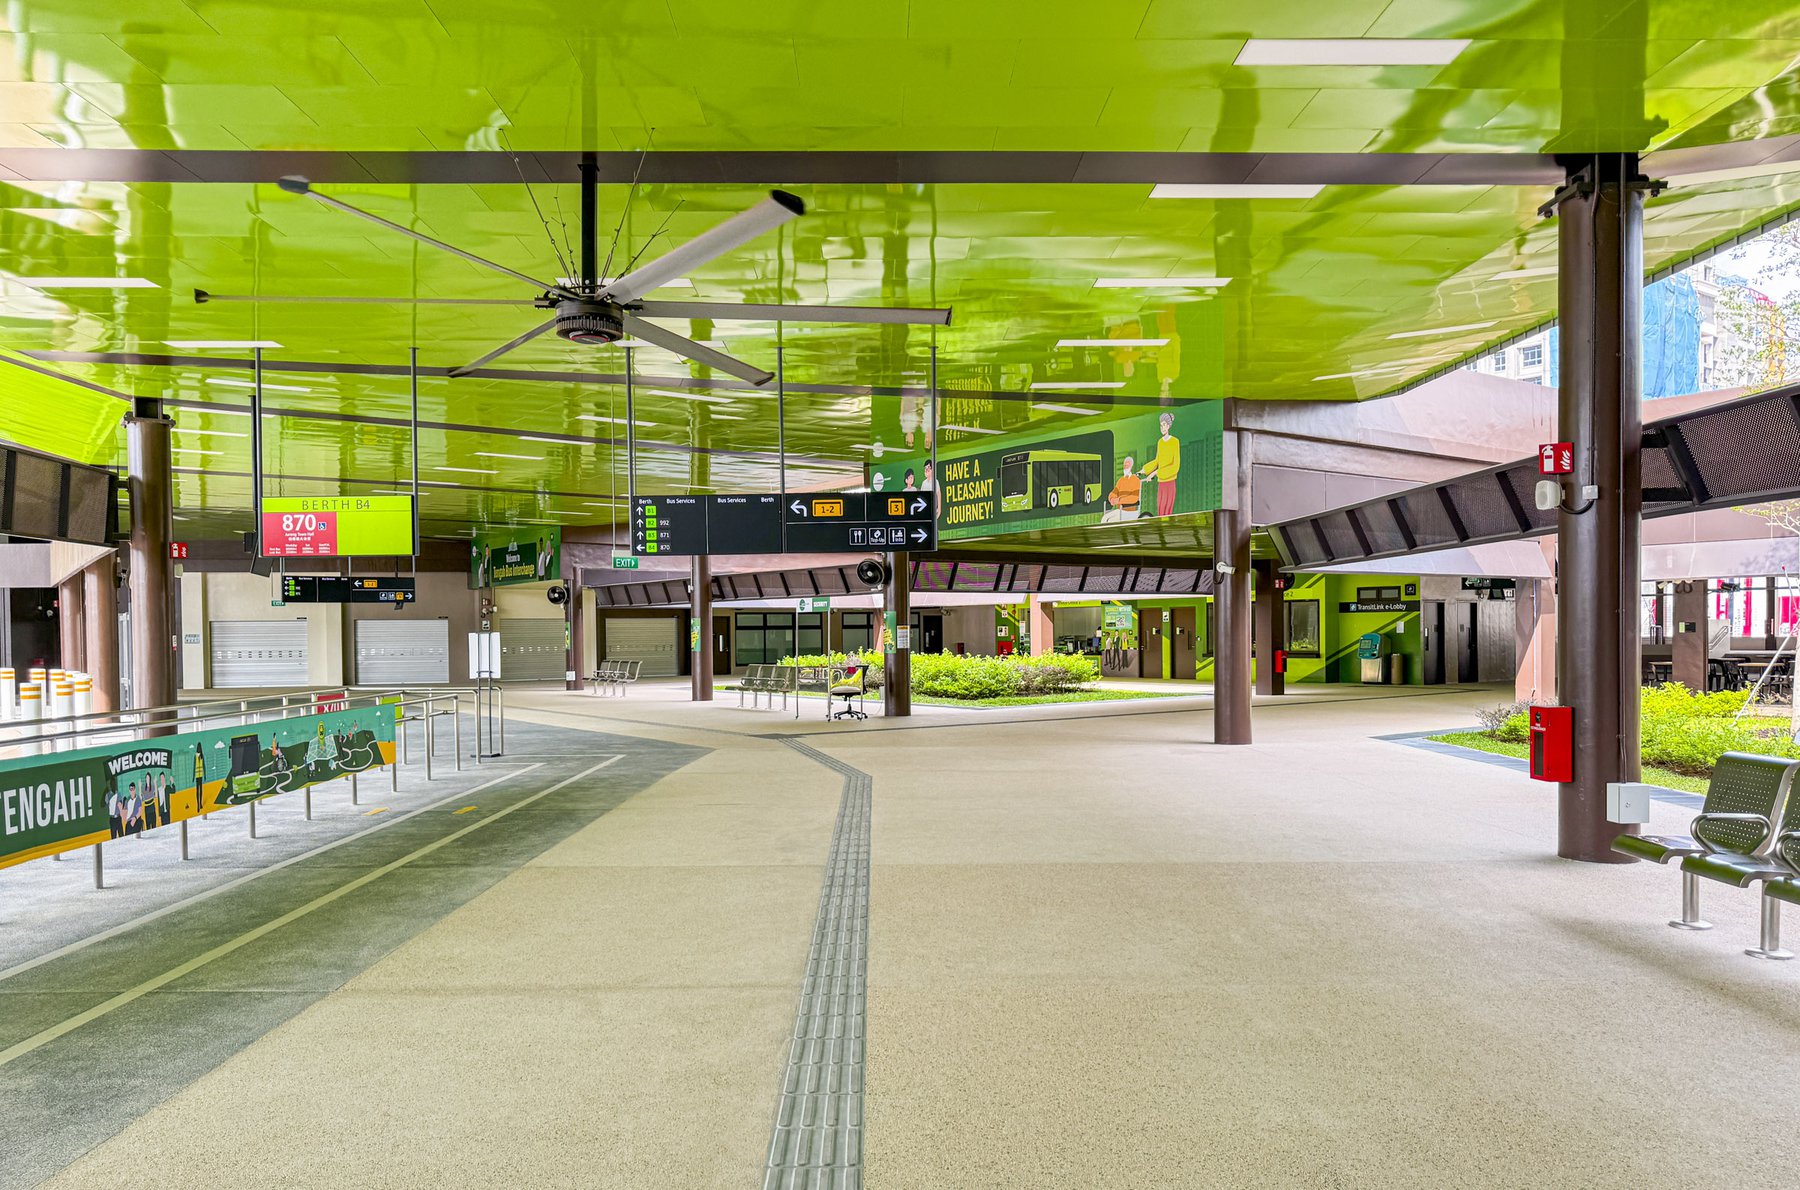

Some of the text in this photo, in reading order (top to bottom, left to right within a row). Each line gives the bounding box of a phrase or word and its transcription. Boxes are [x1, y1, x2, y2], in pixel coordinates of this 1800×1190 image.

[945, 458, 981, 481] HAVE A
[946, 479, 993, 503] PLEASANT
[302, 499, 370, 510] BERTH B4
[821, 505, 835, 514] 1-2
[893, 503, 899, 513] 3
[946, 501, 993, 524] JOURNEY!
[282, 514, 316, 531] 870
[616, 558, 630, 567] EXIT
[1385, 603, 1407, 611] e-Lobby
[108, 751, 168, 776] WELCOME
